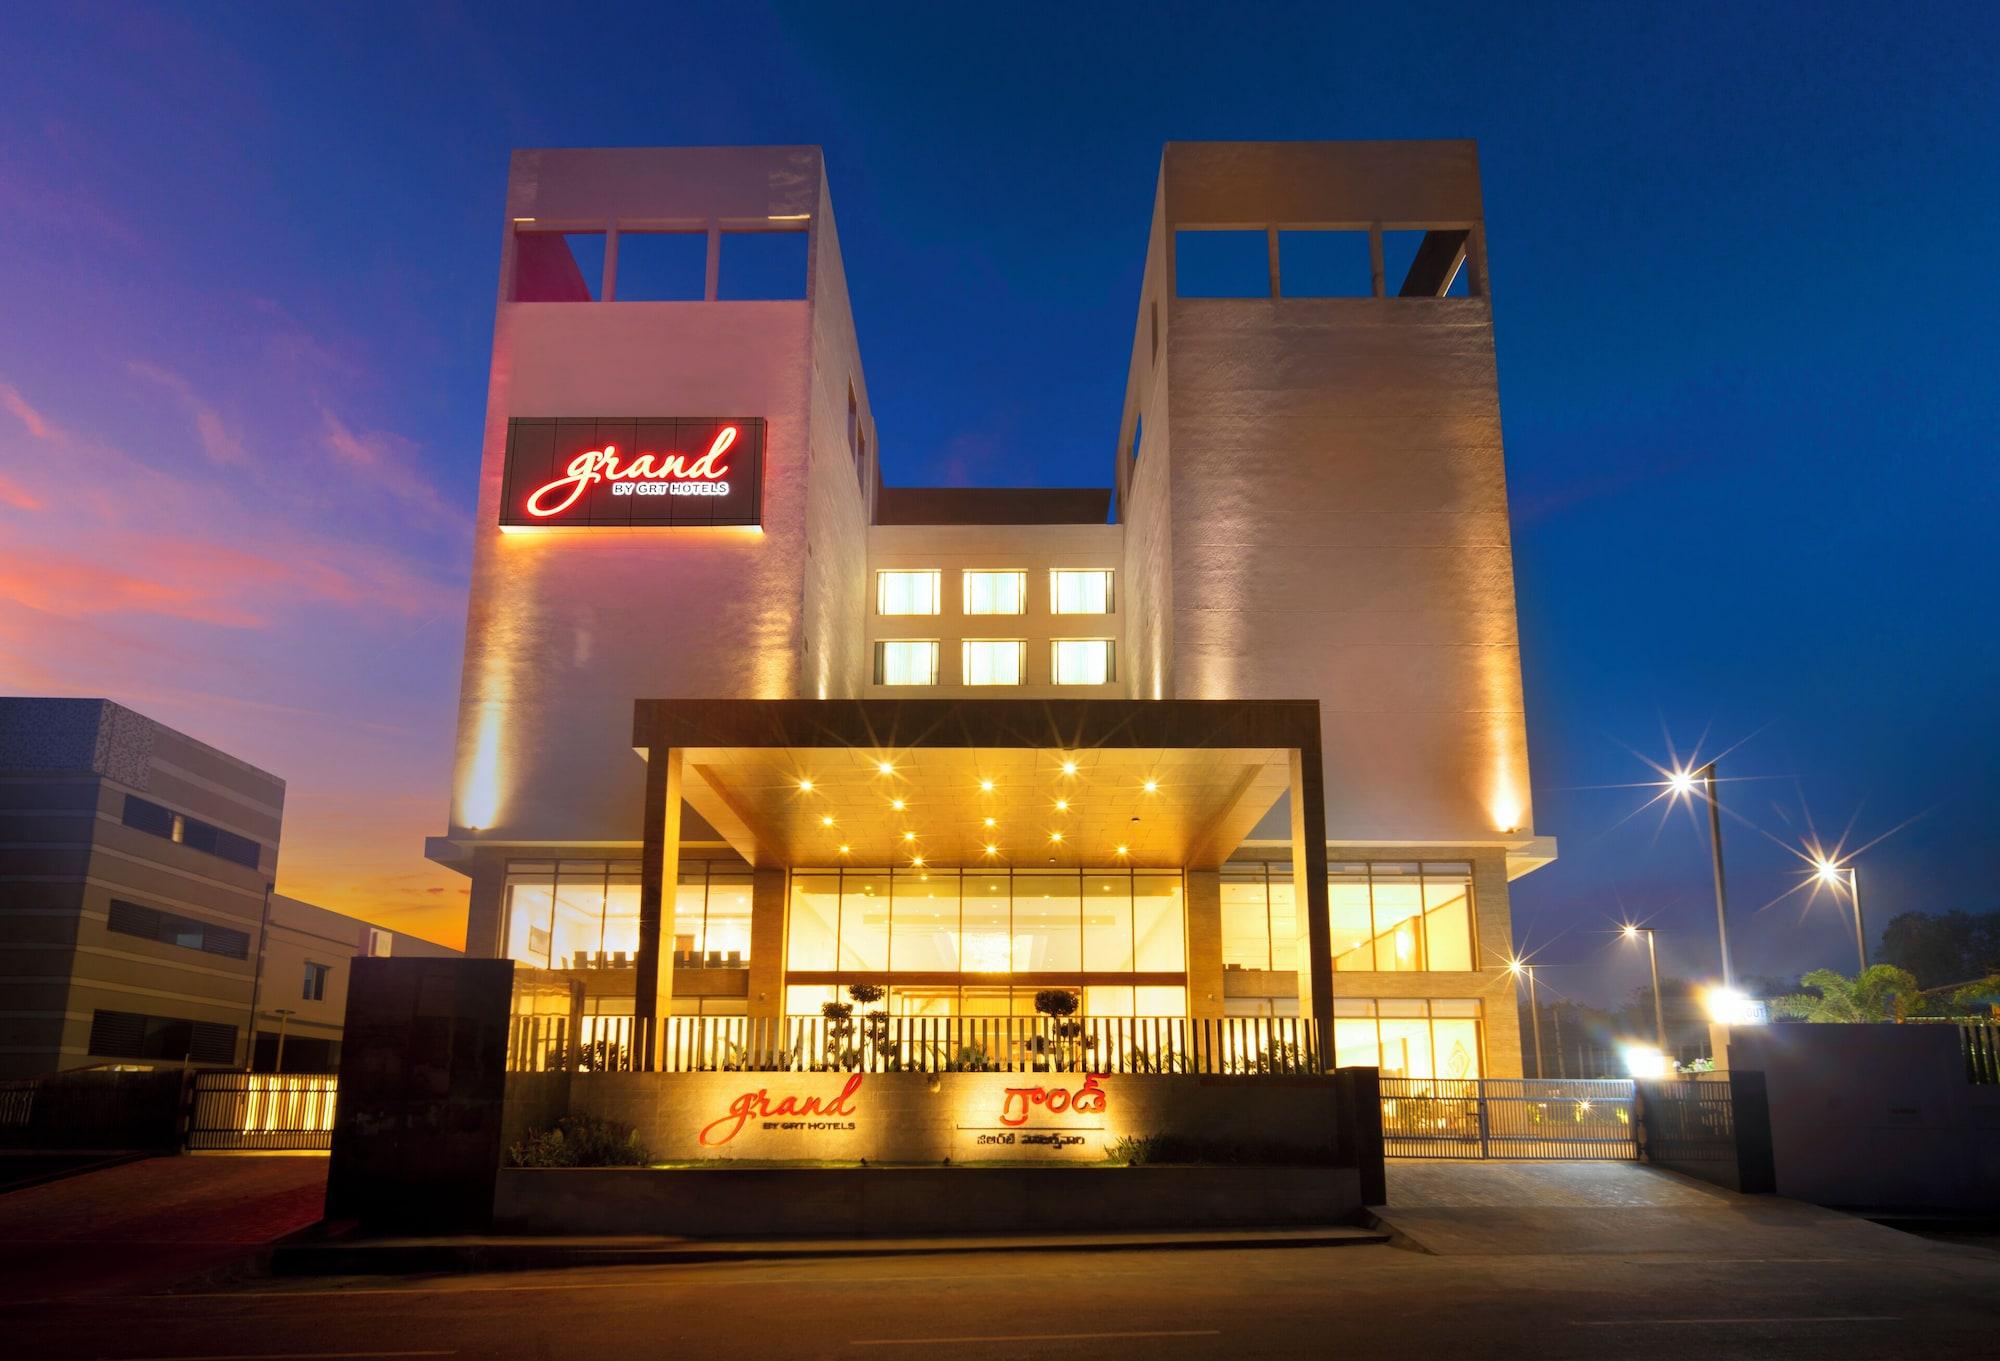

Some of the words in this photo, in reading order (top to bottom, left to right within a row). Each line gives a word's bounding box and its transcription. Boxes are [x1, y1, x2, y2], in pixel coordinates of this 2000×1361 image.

[526, 426, 737, 517] grand
[613, 482, 633, 495] BY
[637, 482, 668, 495] GRT
[670, 482, 729, 496] HOTELS
[699, 1072, 863, 1146] grand
[762, 1122, 780, 1130] BY
[781, 1122, 806, 1130] GRT
[808, 1122, 856, 1130] HOTELS
[1000, 1073, 1111, 1126] గ్రాండ్
